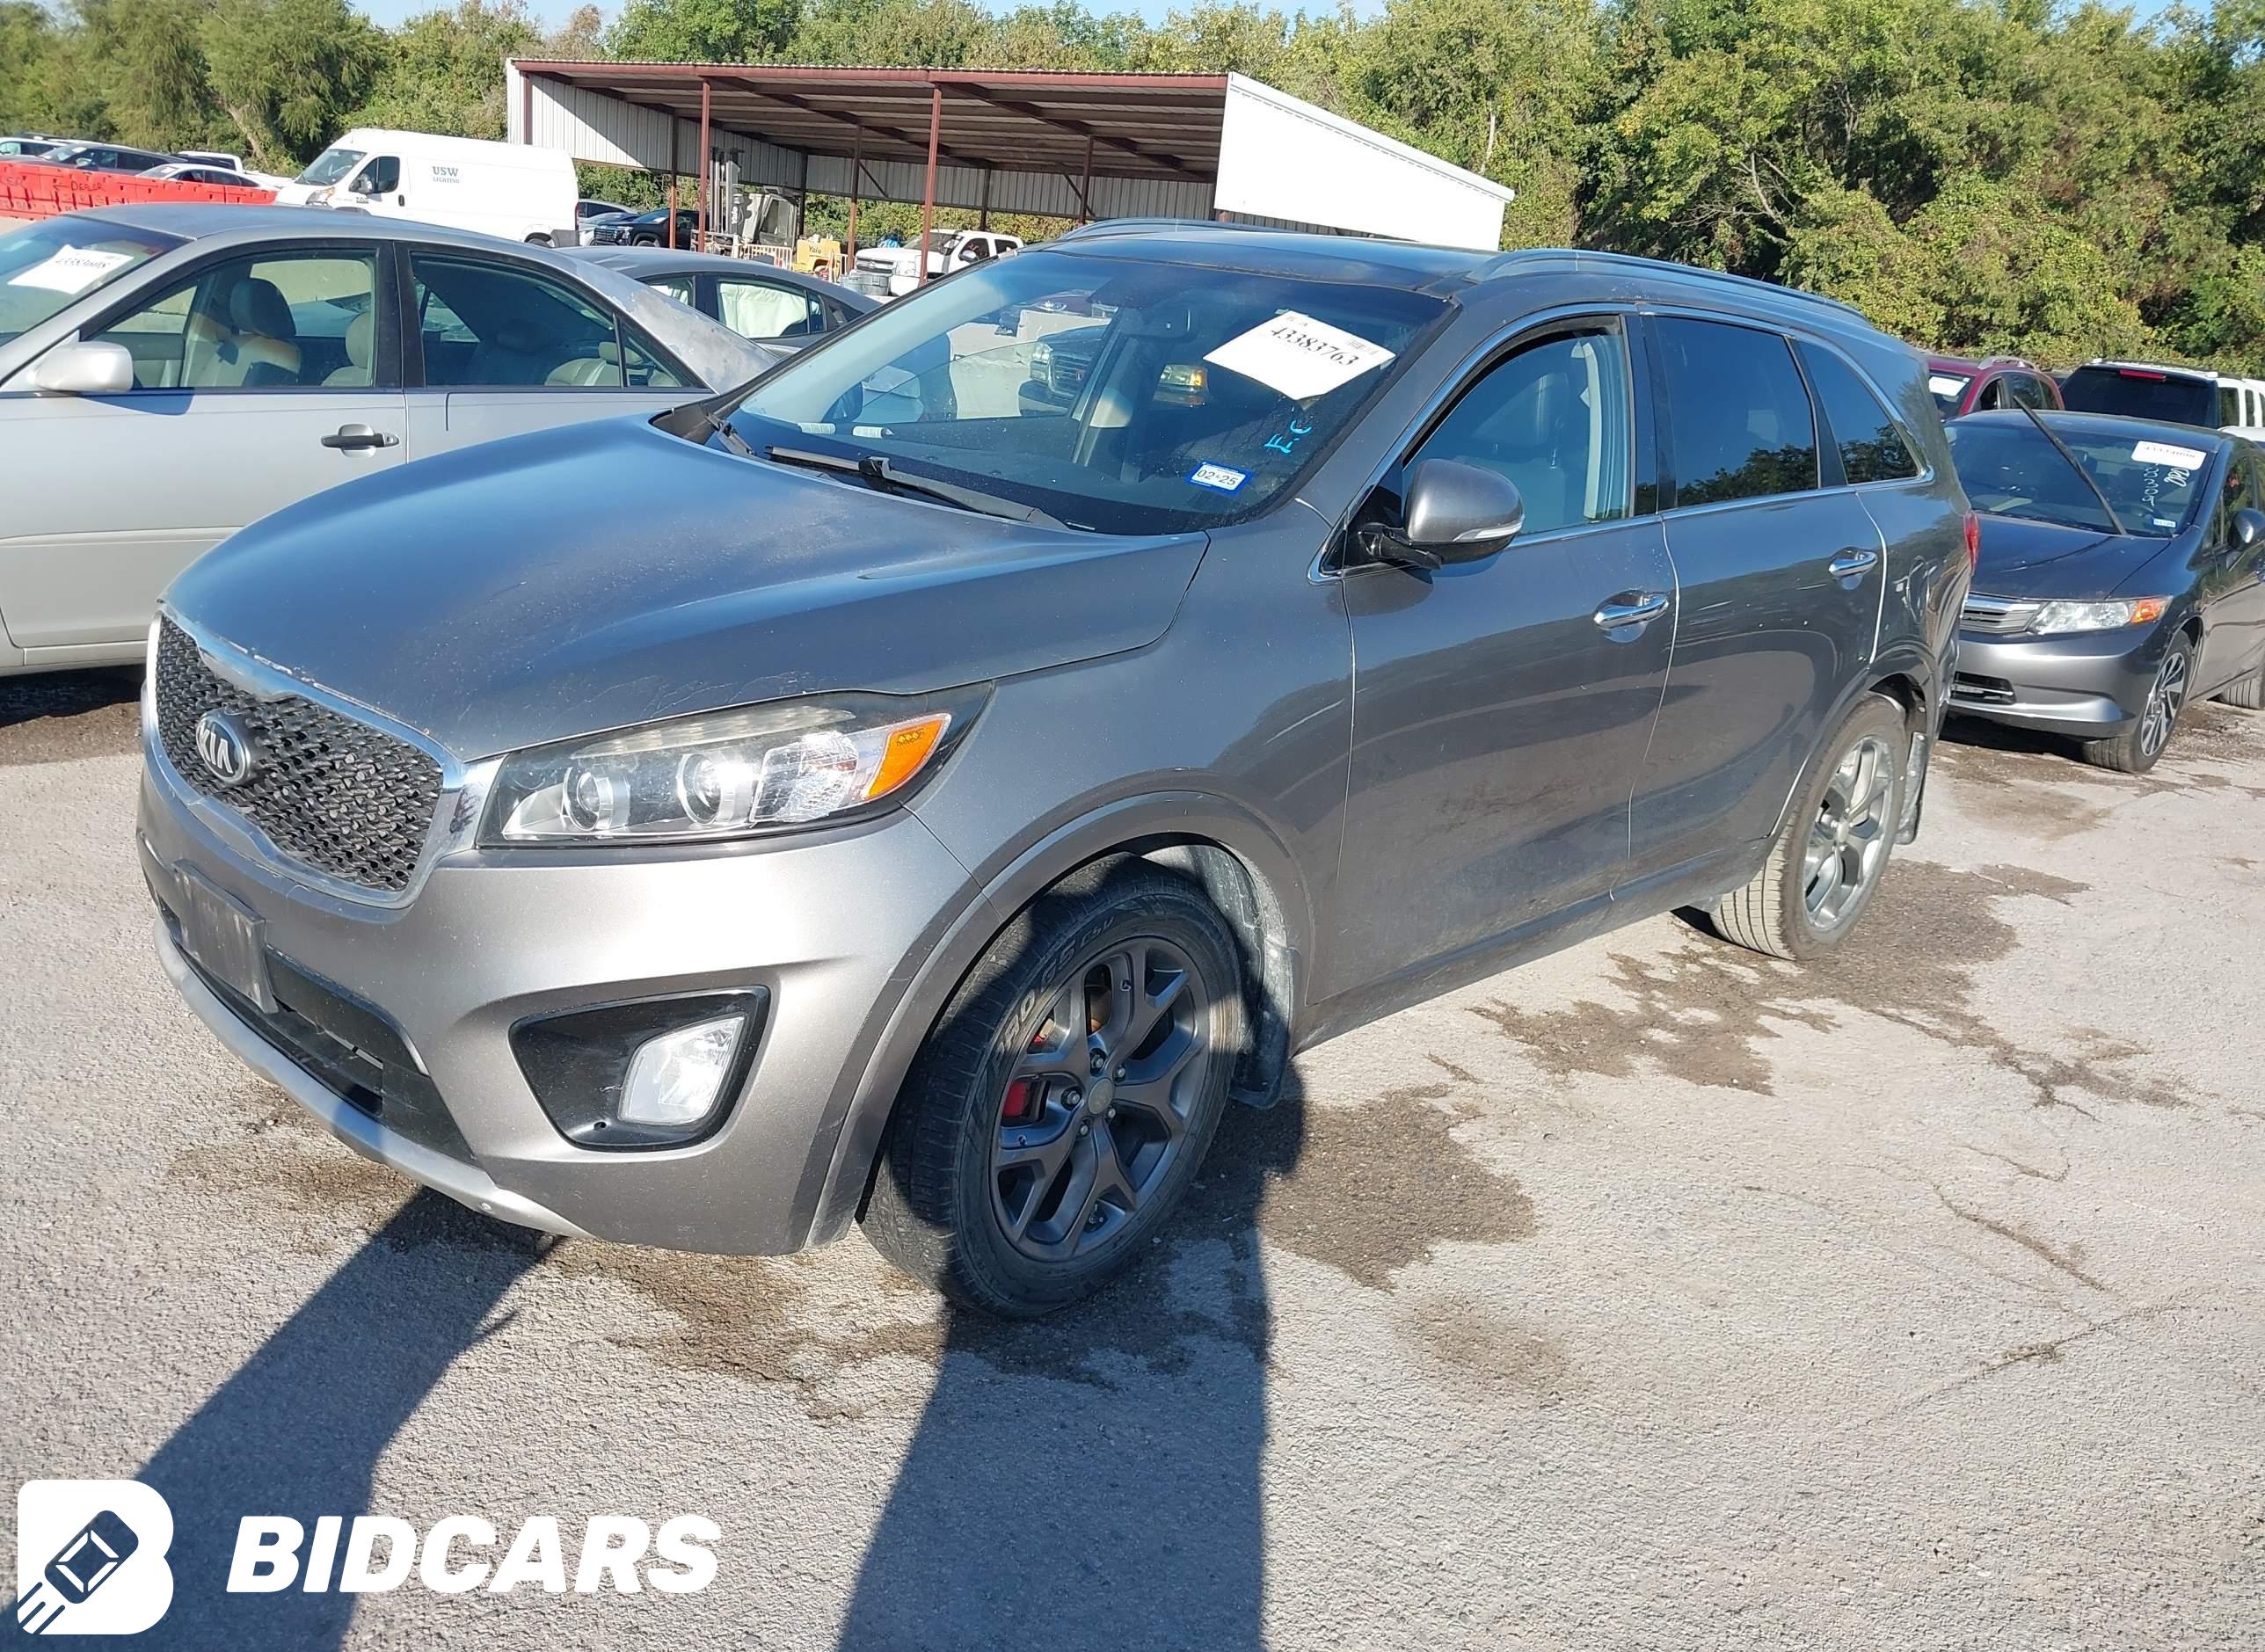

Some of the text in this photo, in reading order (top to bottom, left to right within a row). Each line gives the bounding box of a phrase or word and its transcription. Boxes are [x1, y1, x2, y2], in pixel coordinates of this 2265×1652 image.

[432, 165, 458, 177] USW
[808, 244, 822, 254] Yale
[1271, 327, 1359, 365] 43383763
[200, 720, 234, 775] KIA
